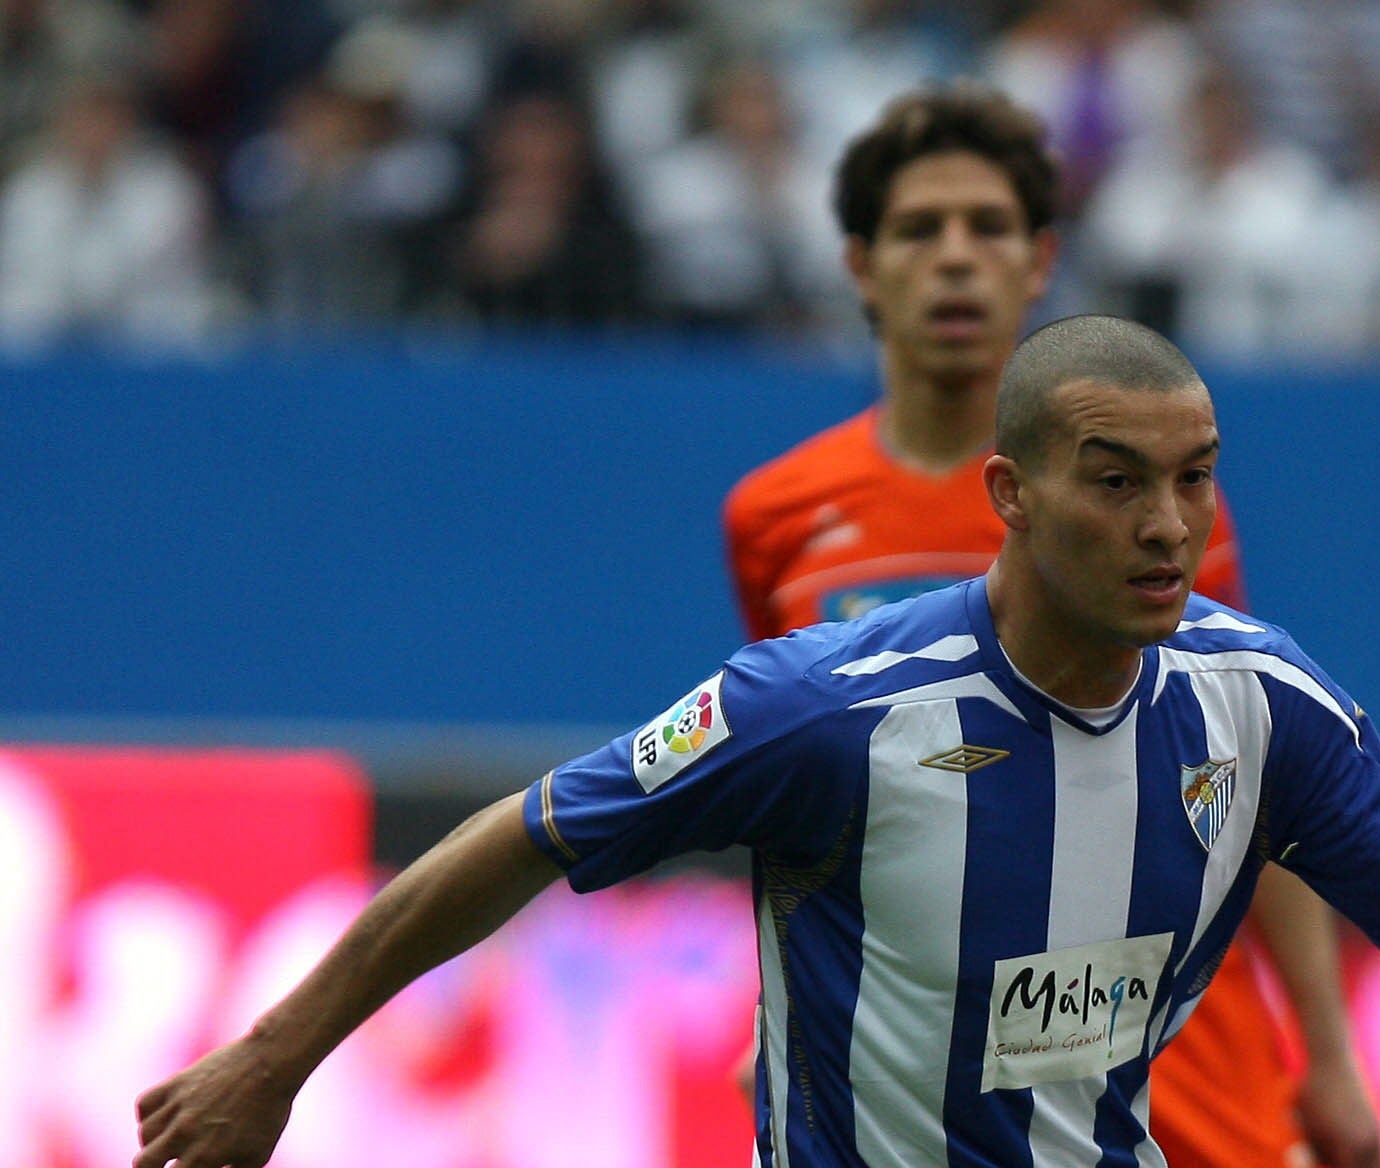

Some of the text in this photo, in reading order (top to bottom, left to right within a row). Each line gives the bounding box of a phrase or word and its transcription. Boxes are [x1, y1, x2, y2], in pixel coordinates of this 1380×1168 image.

[638, 728, 657, 766] LFP
[1000, 963, 1148, 1047] Málaga
[993, 1023, 1107, 1058] Ciudad Genial
